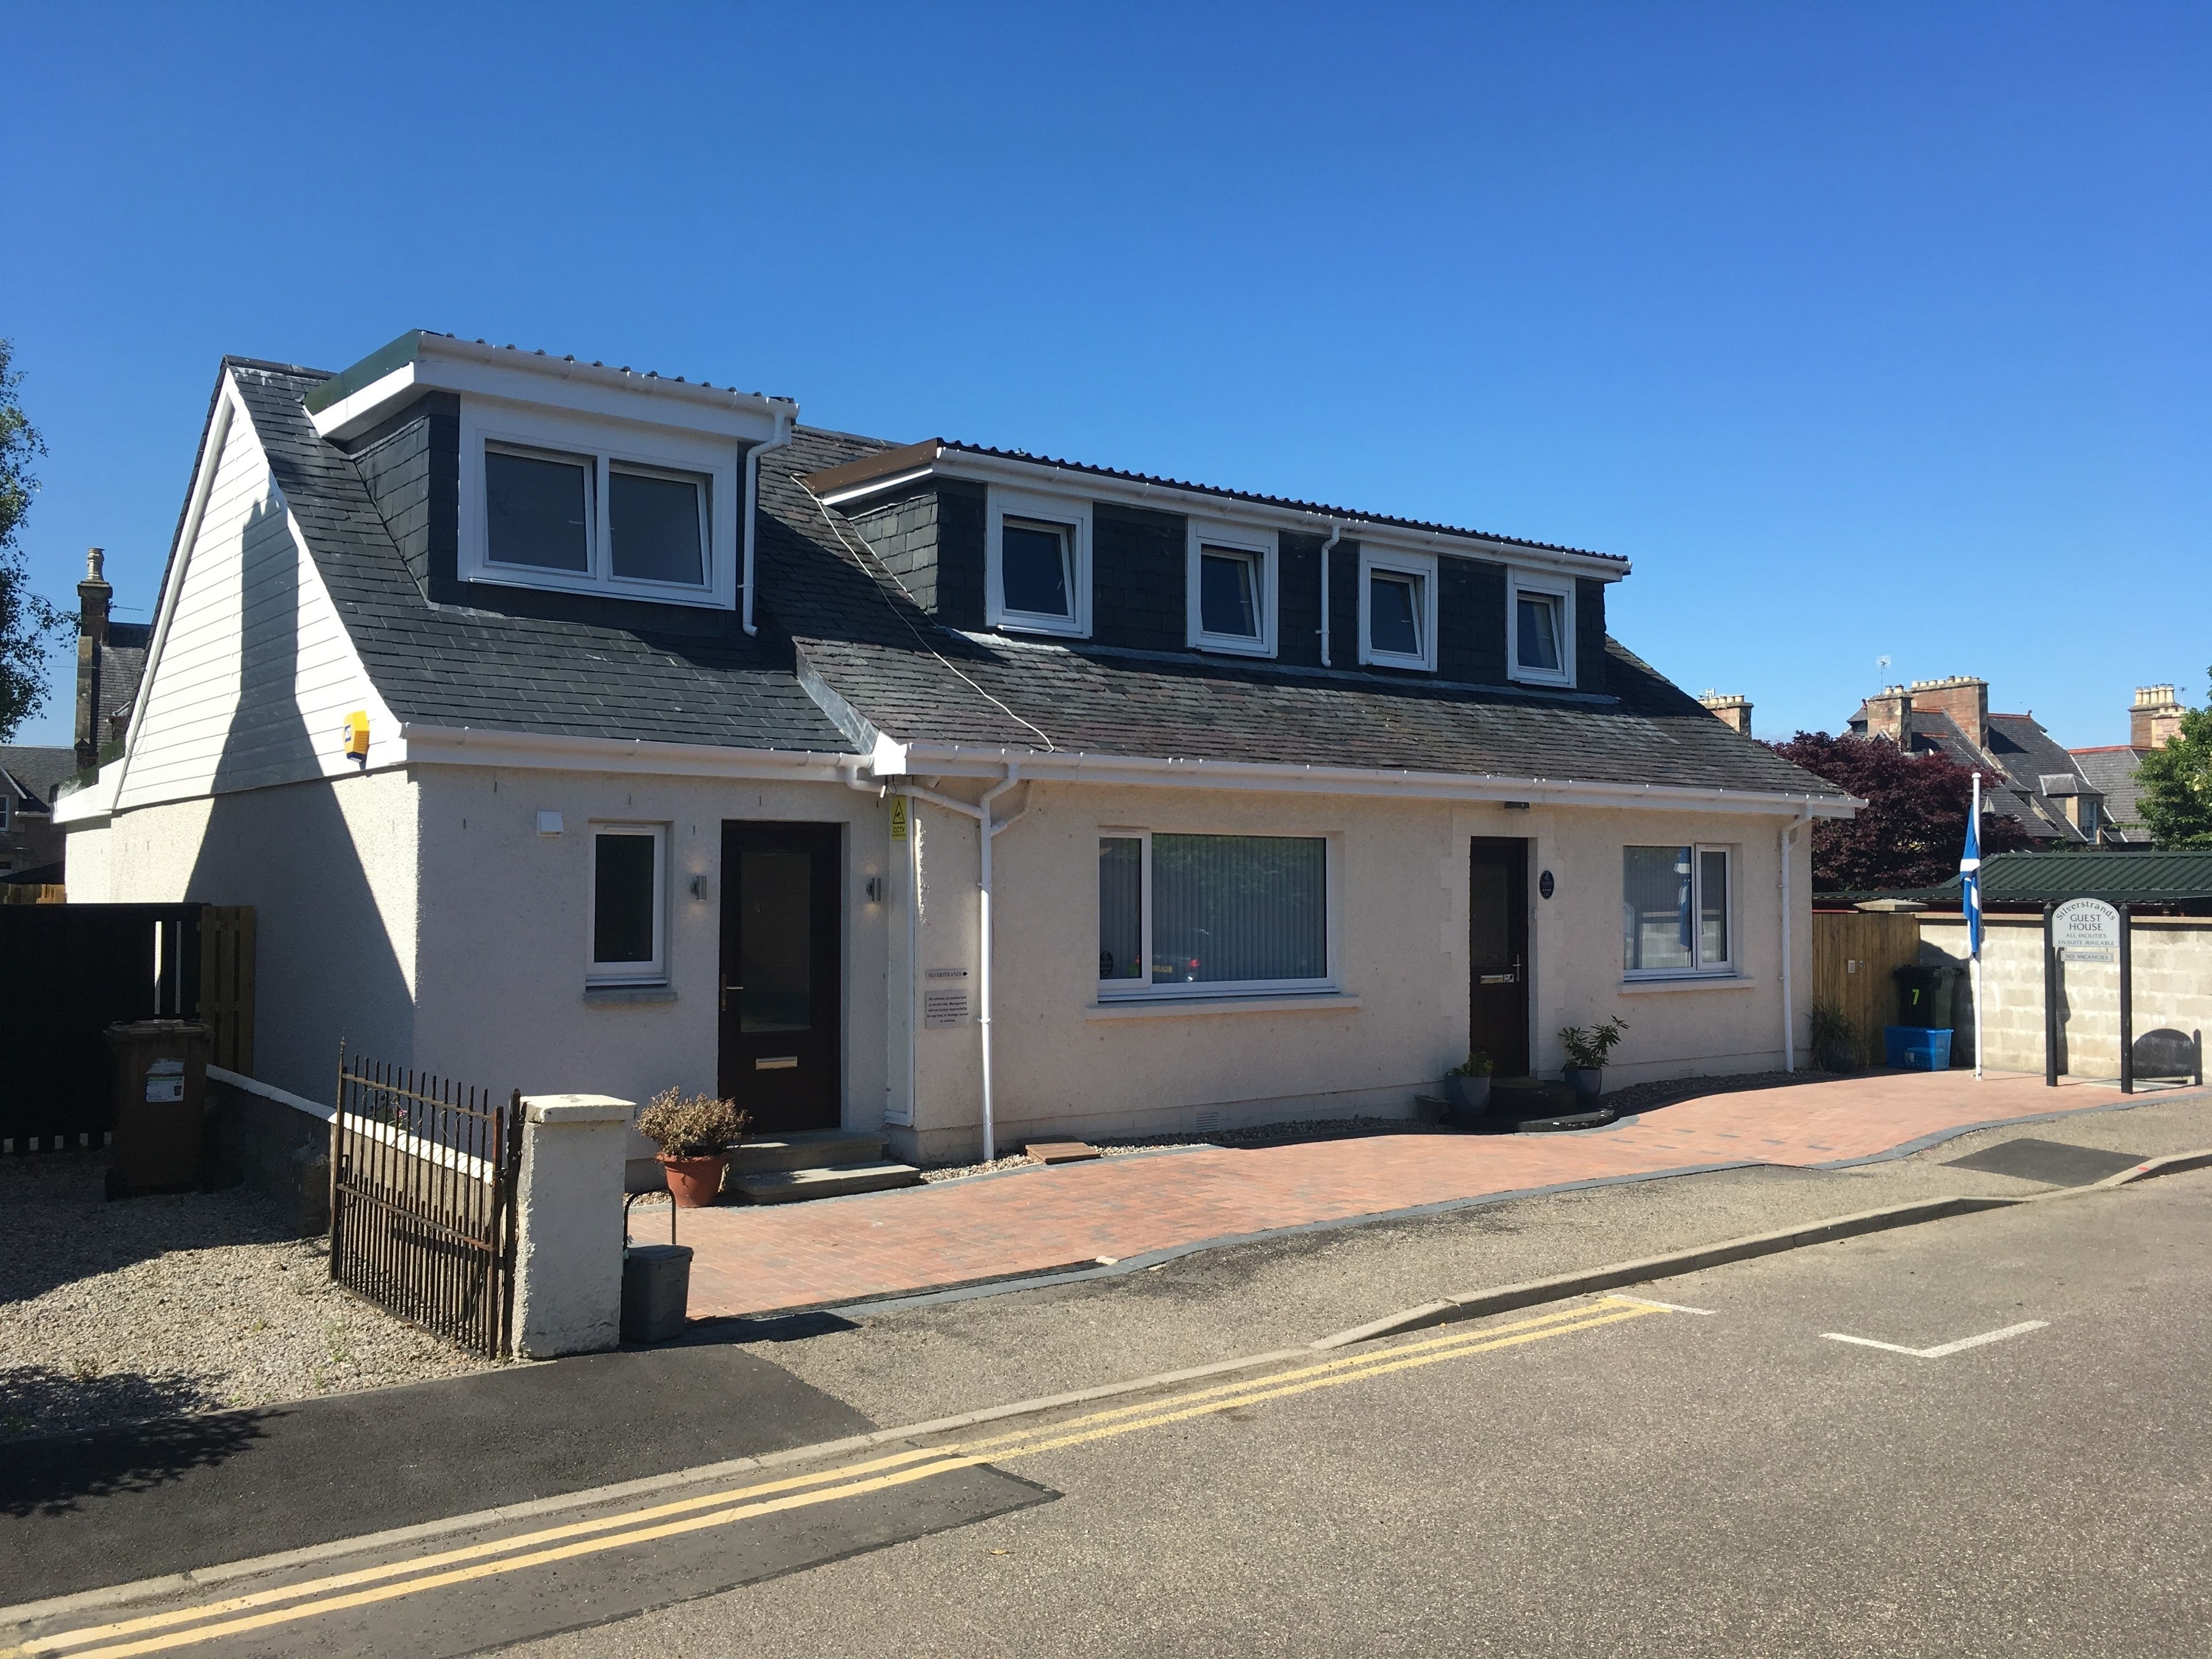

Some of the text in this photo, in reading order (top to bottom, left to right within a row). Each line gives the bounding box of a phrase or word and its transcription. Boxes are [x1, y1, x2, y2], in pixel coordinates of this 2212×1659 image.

[2056, 900, 2116, 921] Silverstrands
[2069, 923, 2103, 931] HOUSE
[1912, 989, 1919, 1005] 7
